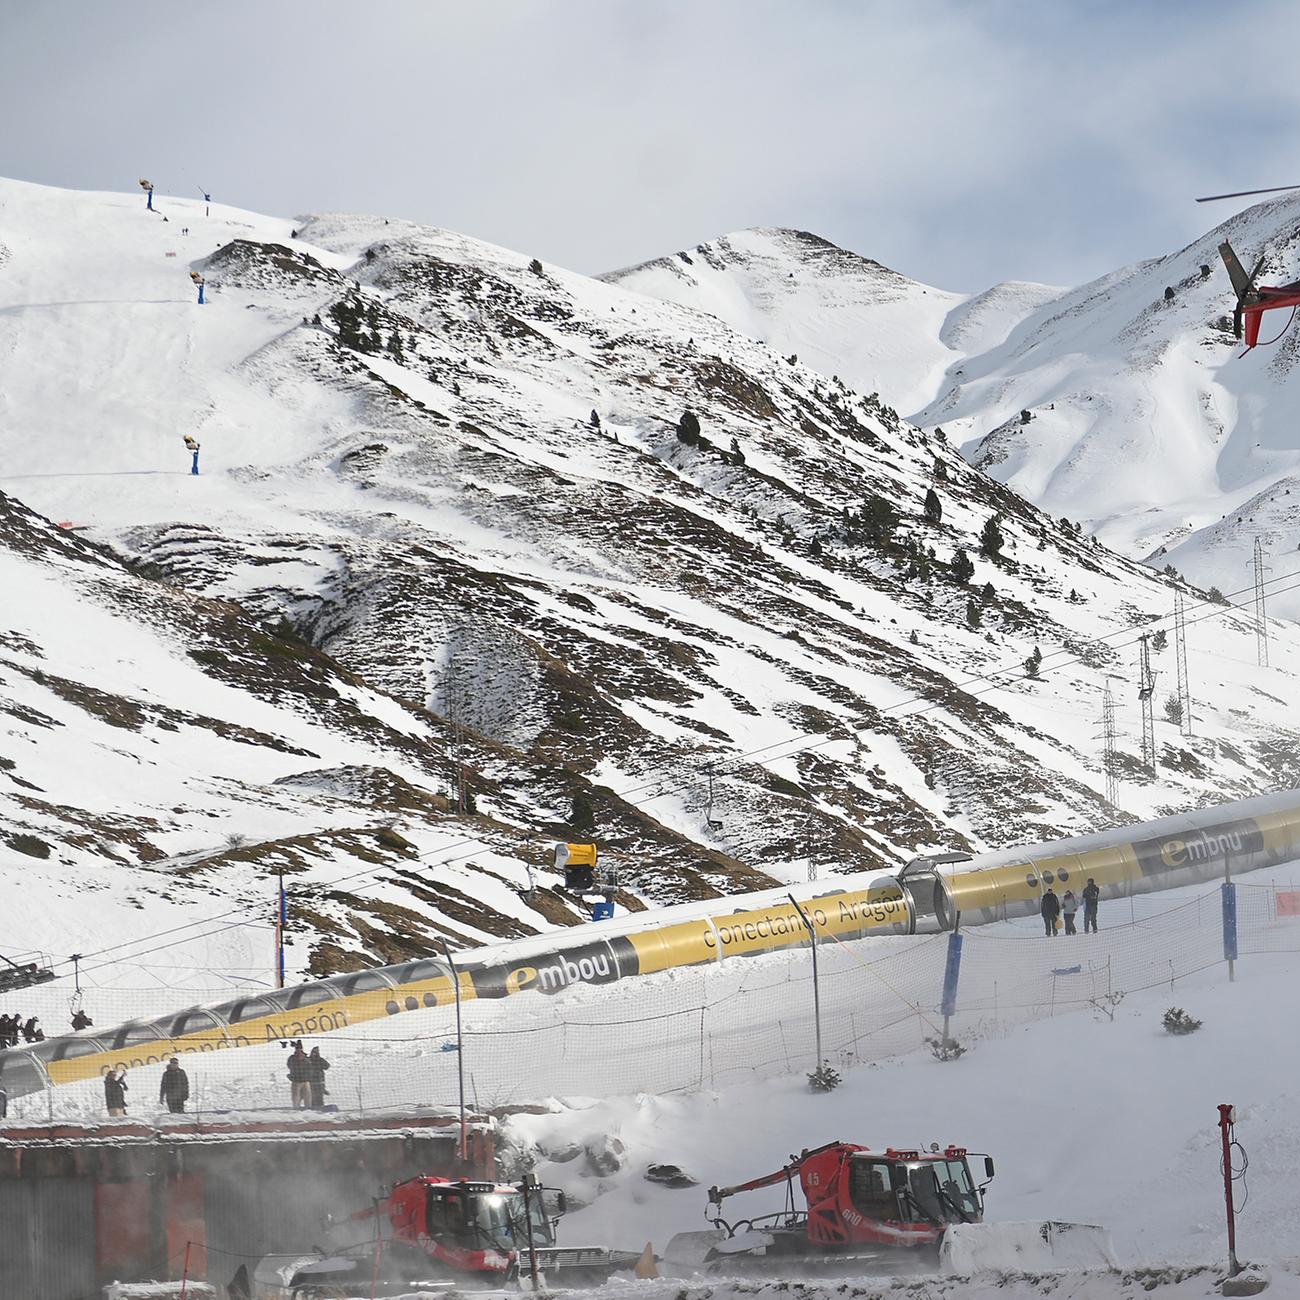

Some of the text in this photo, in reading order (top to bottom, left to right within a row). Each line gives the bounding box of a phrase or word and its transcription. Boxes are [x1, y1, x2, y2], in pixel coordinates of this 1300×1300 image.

[1161, 831, 1242, 866] embou
[704, 890, 908, 948] conectando Aragón
[506, 953, 610, 994] embou
[266, 1008, 348, 1042] Aragón
